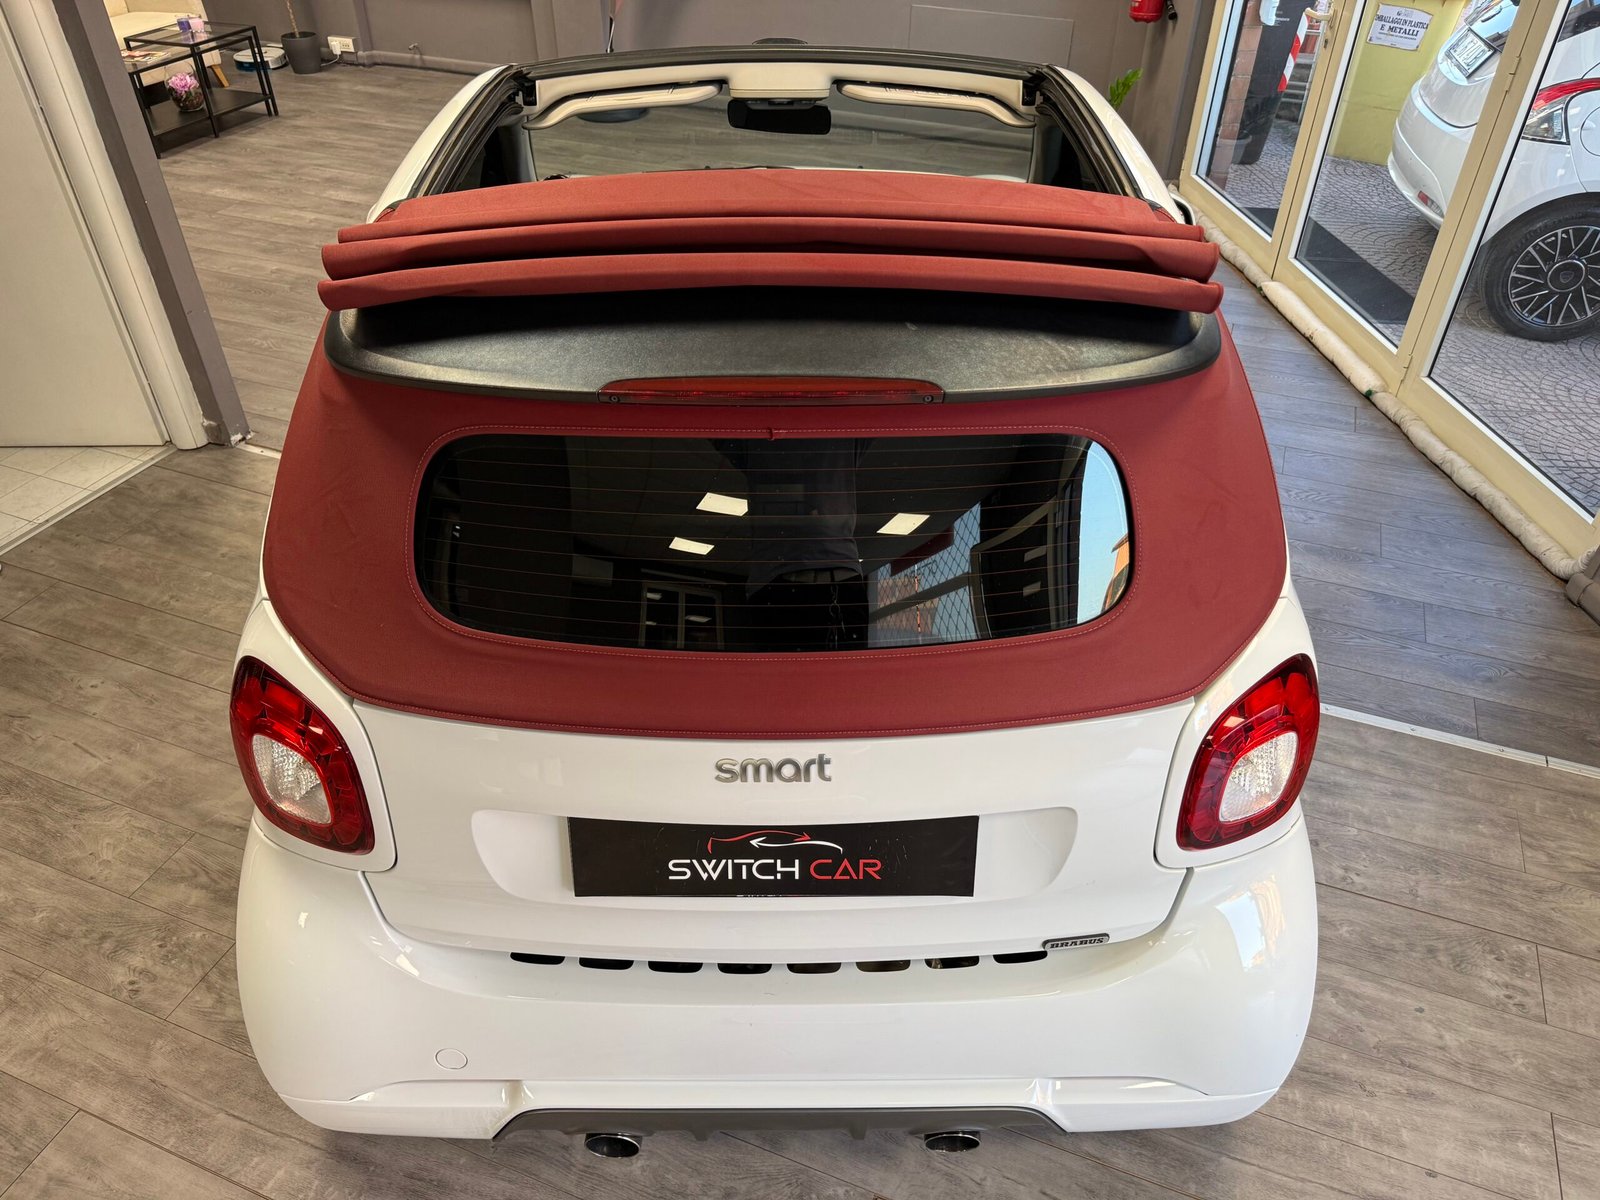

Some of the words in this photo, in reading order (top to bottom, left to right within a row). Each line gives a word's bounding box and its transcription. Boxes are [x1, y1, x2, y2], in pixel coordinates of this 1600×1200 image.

[1388, 25, 1420, 37] METALLI
[714, 753, 832, 783] smart
[668, 858, 799, 881] SWITCH
[809, 859, 882, 880] CAR
[1049, 937, 1105, 949] BRABUS
